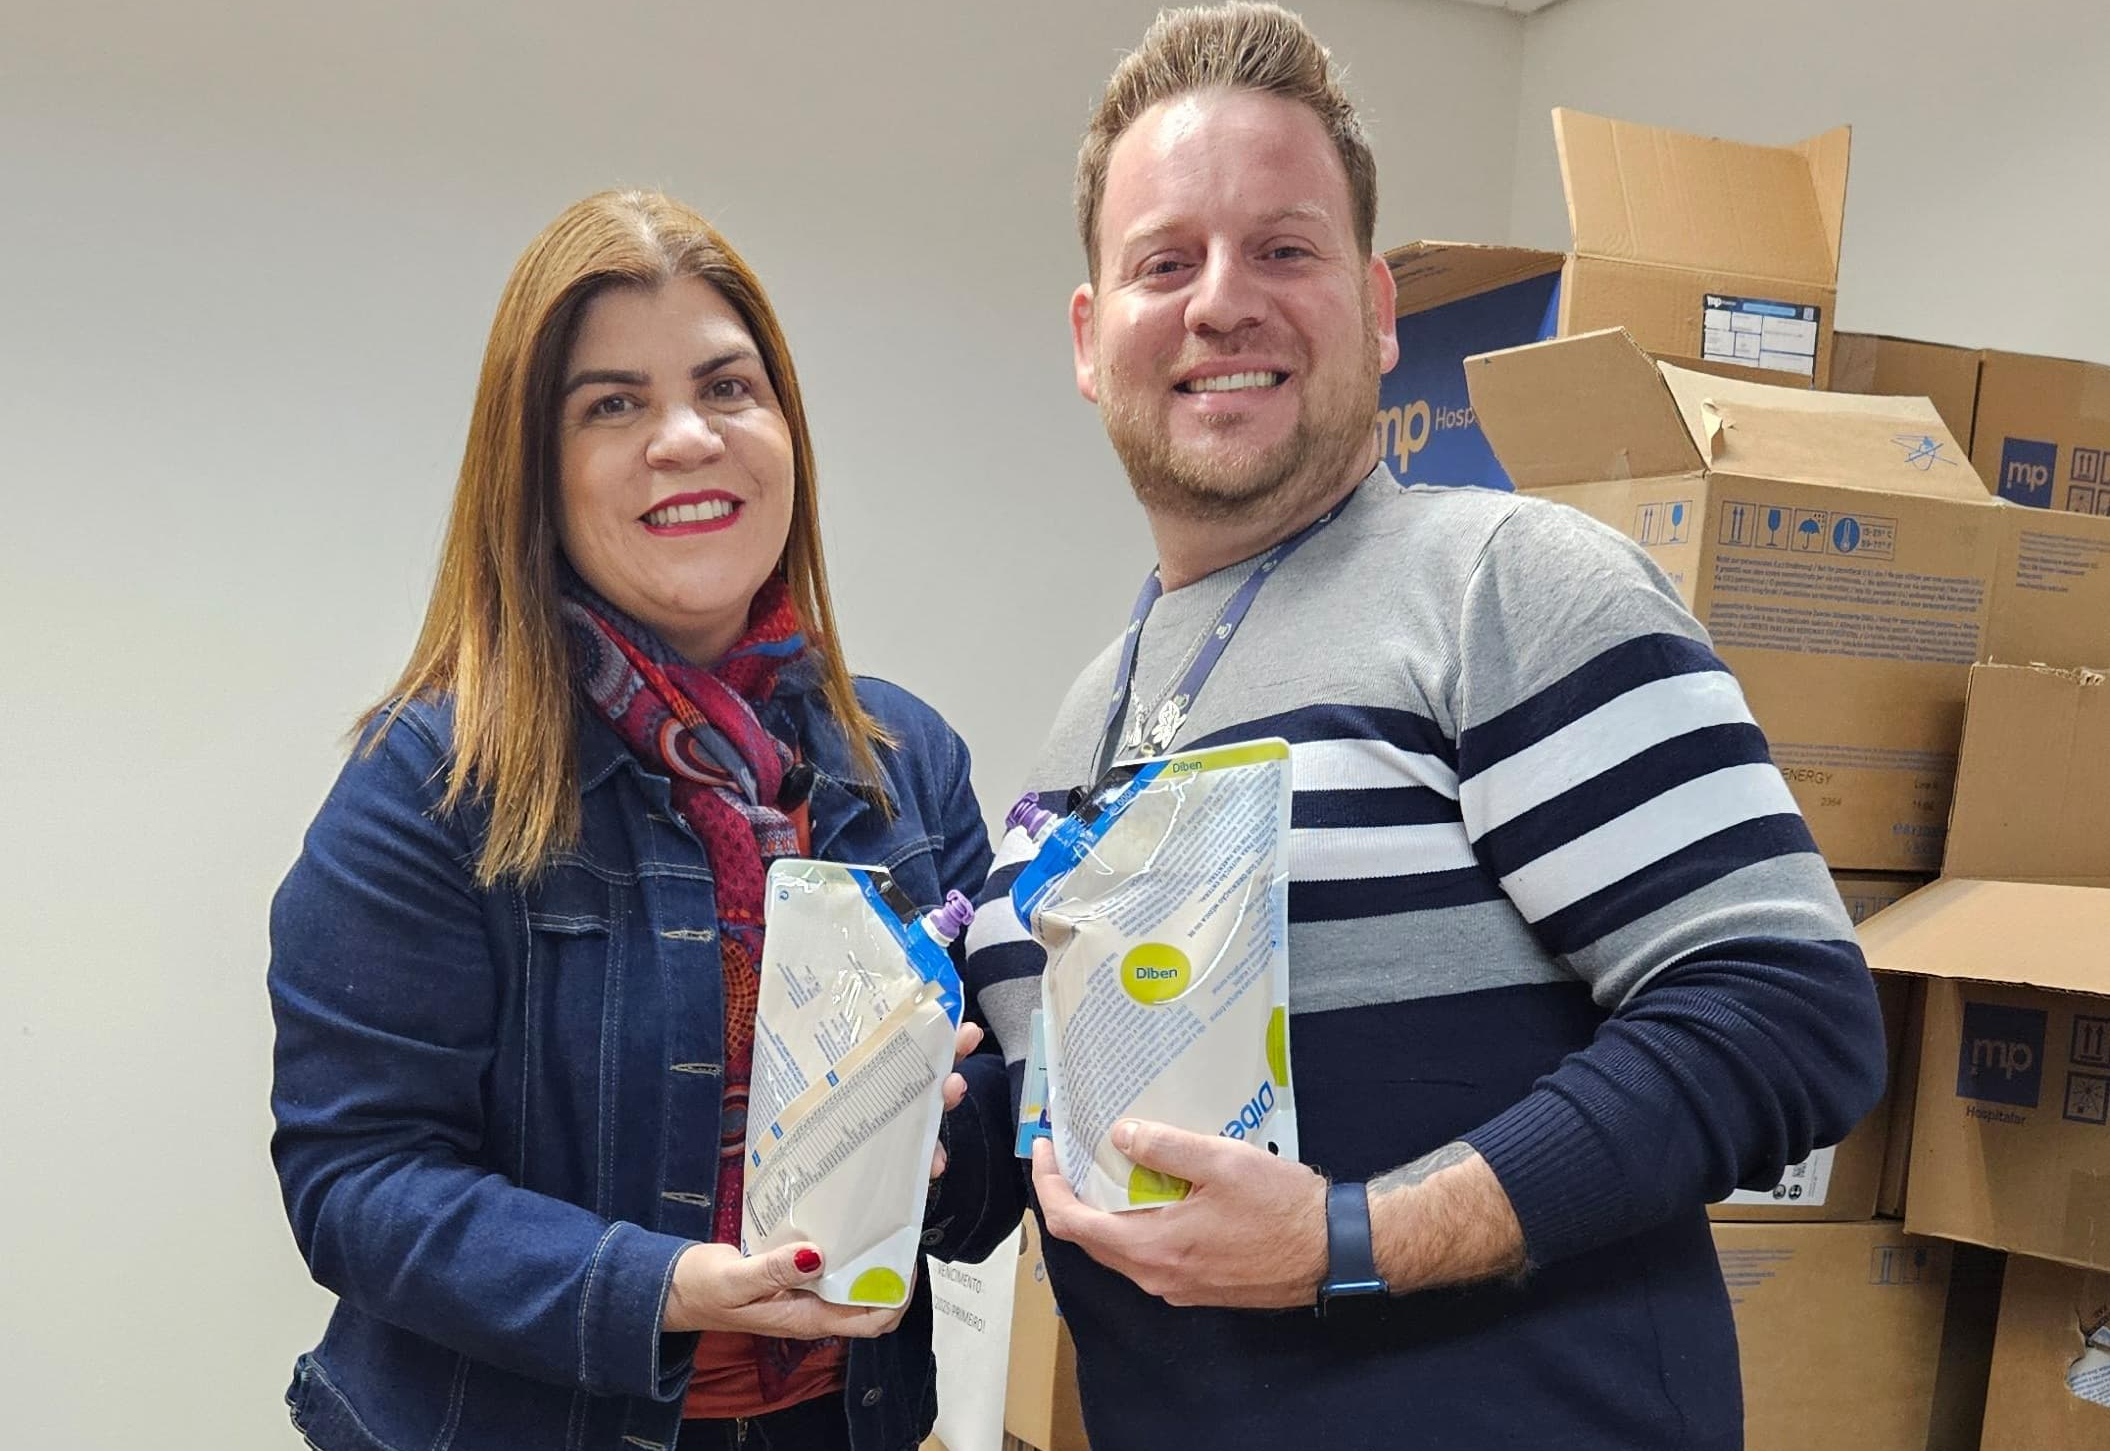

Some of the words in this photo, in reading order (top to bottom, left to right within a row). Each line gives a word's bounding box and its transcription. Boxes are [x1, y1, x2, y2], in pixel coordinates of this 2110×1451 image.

[2006, 461, 2048, 492] mp
[1173, 761, 1203, 773] Diben
[1782, 767, 1833, 784] ENERGY
[1136, 967, 1177, 979] Diben
[1970, 1039, 2032, 1079] mp
[1219, 1080, 1274, 1141] Dibe
